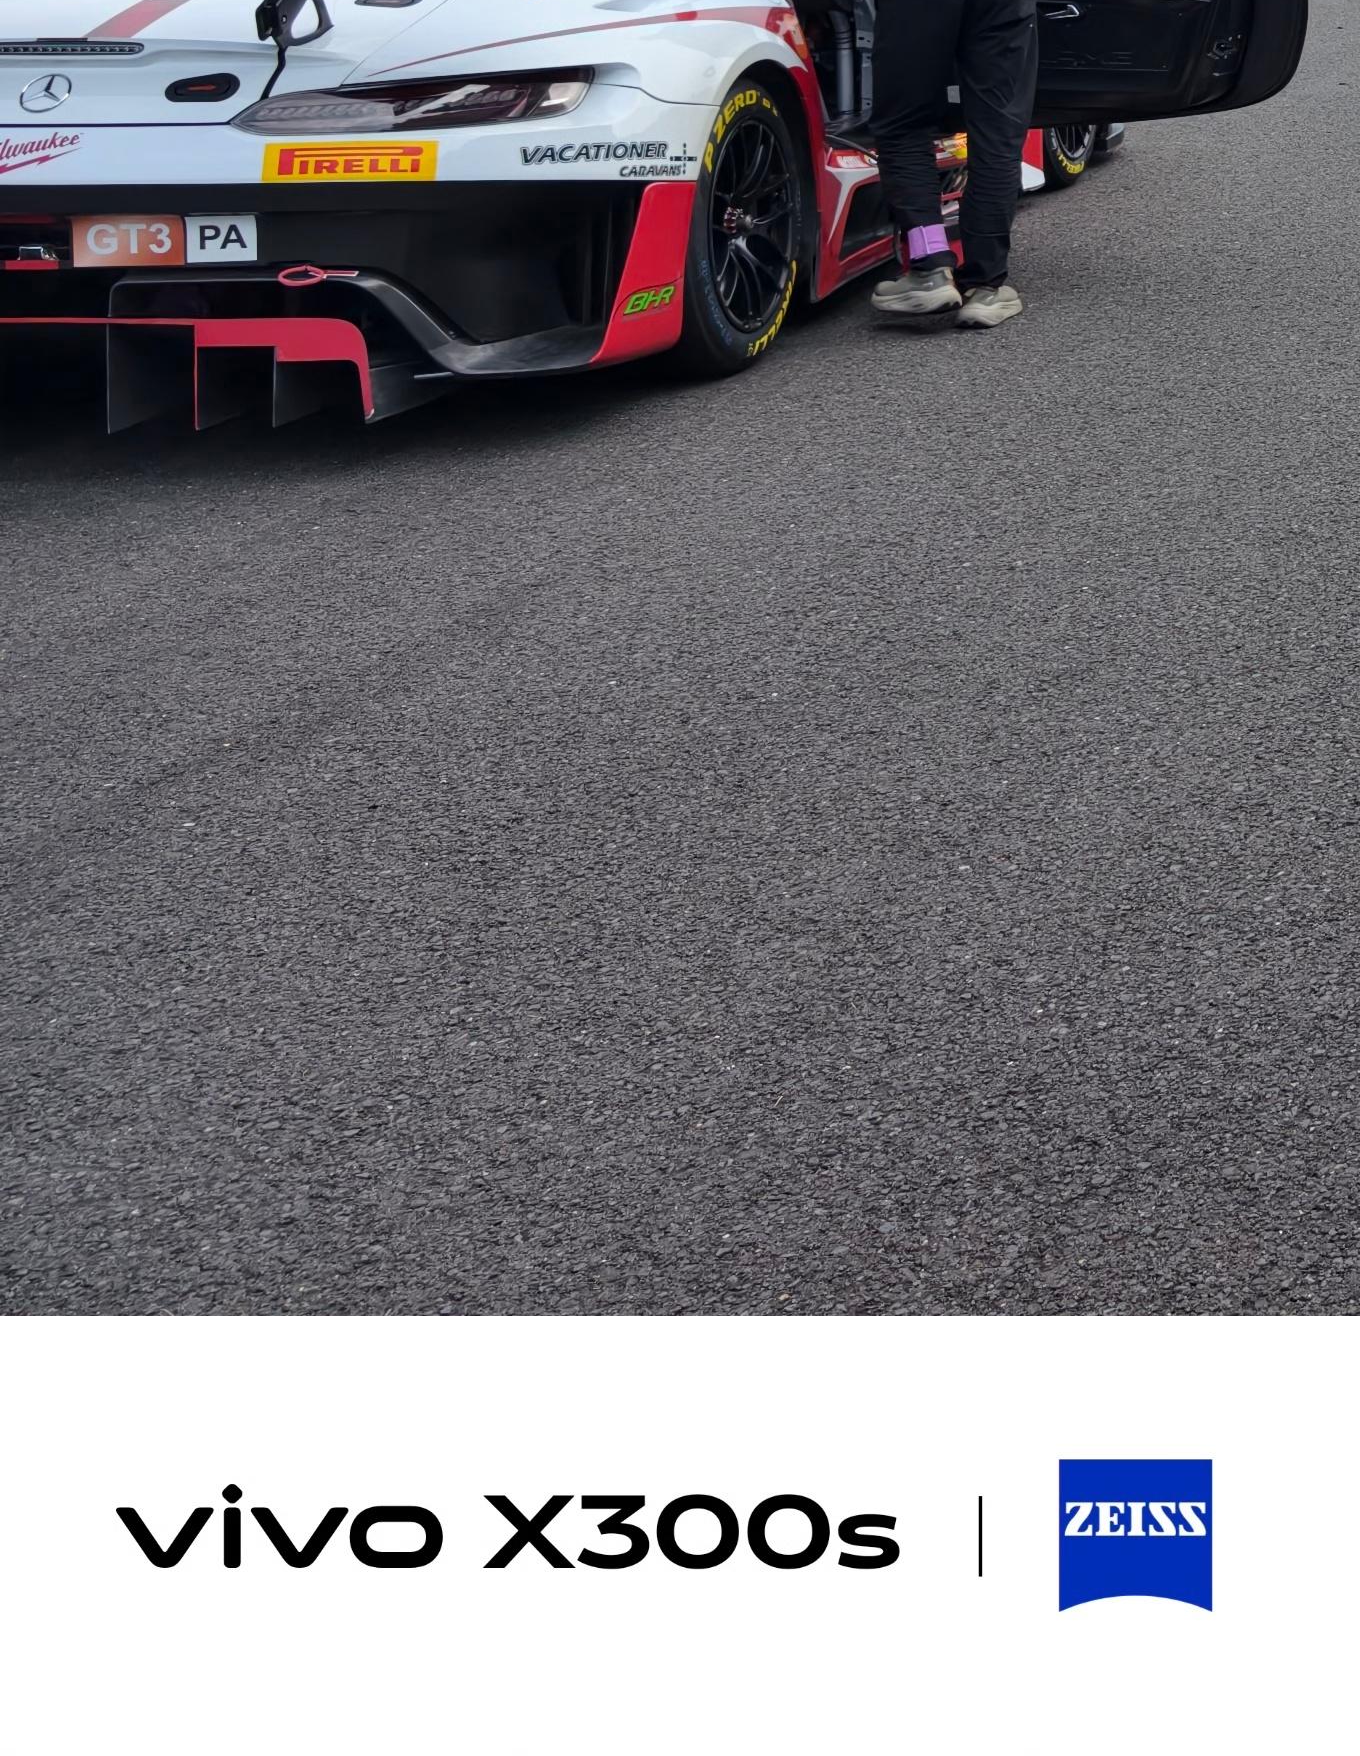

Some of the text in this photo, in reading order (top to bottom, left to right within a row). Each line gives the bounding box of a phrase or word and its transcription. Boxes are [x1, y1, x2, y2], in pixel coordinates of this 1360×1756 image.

[277, 146, 424, 176] PIRELLI
[520, 141, 669, 166] VACATIONER
[86, 222, 249, 256] GT3 PA
